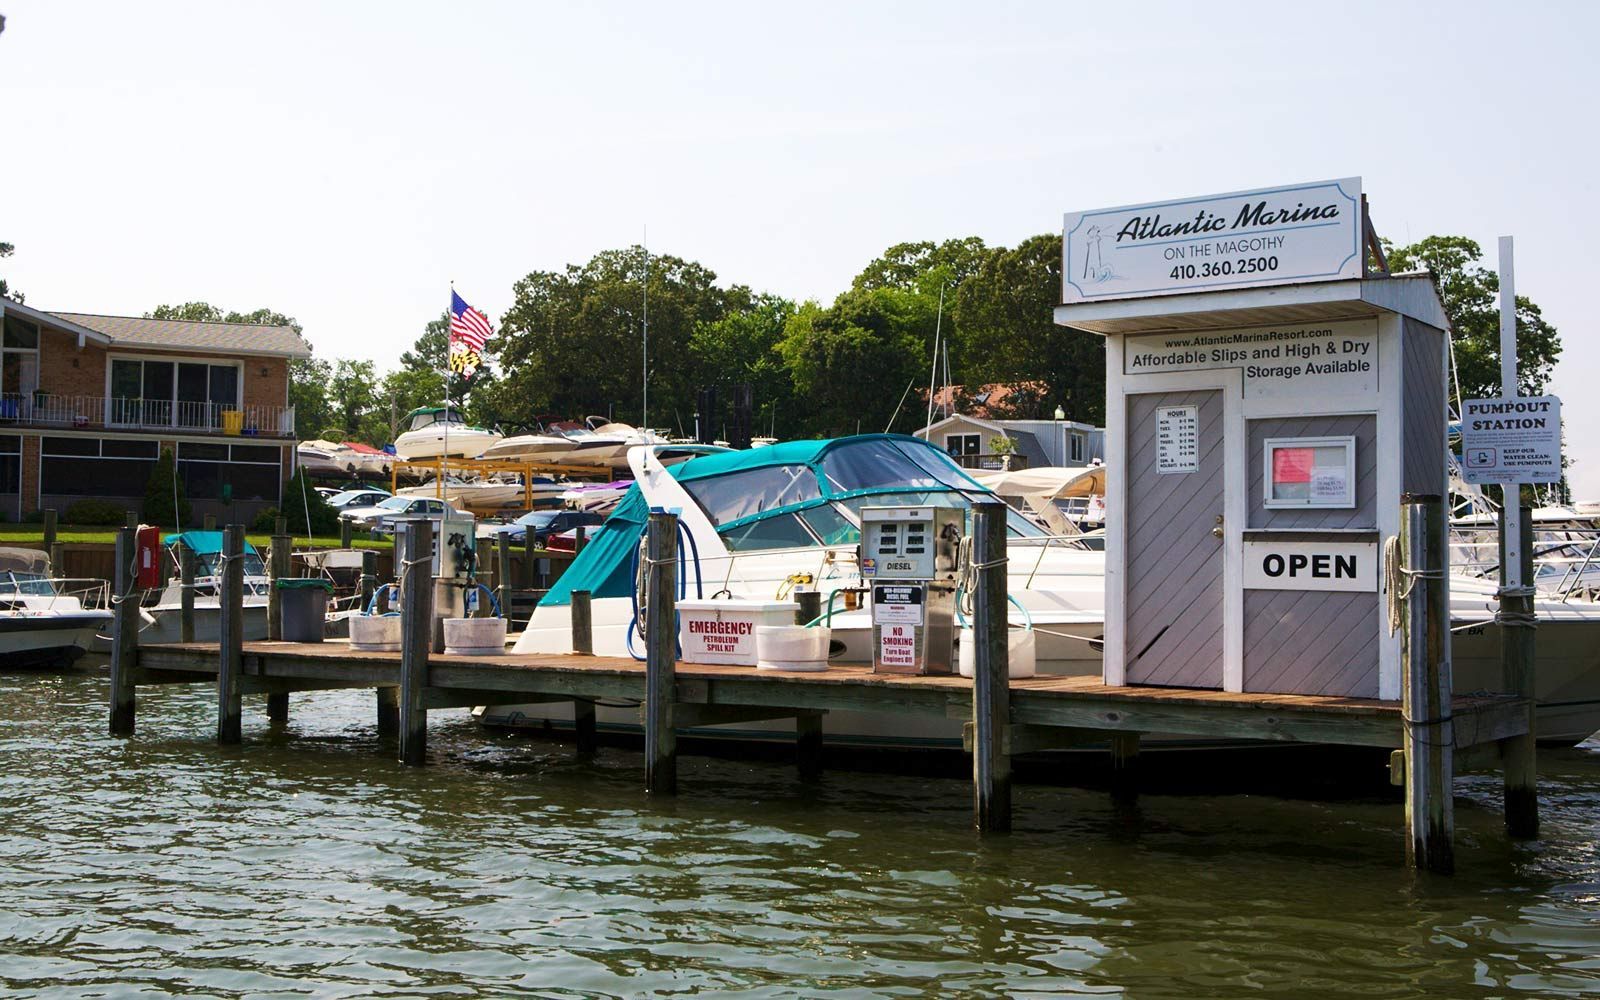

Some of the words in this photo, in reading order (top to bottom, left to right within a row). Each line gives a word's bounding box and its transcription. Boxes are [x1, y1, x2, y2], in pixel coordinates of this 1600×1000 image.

[1116, 210, 1225, 242] Atlantic
[1230, 201, 1339, 229] Marina
[1164, 247, 1185, 260] ON
[1189, 243, 1211, 257] THE
[1216, 236, 1285, 254] MAGOTHY
[1170, 256, 1278, 279] 410.360.2500
[1165, 329, 1332, 348] www.AtlanticMarinaResort.com
[1132, 352, 1206, 367] Affordable
[1211, 349, 1247, 363] Slips
[1252, 346, 1280, 359] and
[1285, 343, 1320, 359] High
[1326, 341, 1337, 354] &
[1343, 340, 1370, 355] Dry
[1247, 366, 1301, 379] Storage
[1305, 360, 1370, 375] Available
[1468, 402, 1550, 414] PUMPOUT
[1472, 418, 1546, 430] STATION
[887, 562, 912, 570] DIESEL
[1263, 554, 1357, 578] OPEN
[689, 621, 753, 634] EMERGENCY
[892, 627, 902, 636] NO
[703, 635, 739, 644] PETROLEUM
[883, 637, 913, 646] SMOKING
[724, 644, 735, 652] KIT
